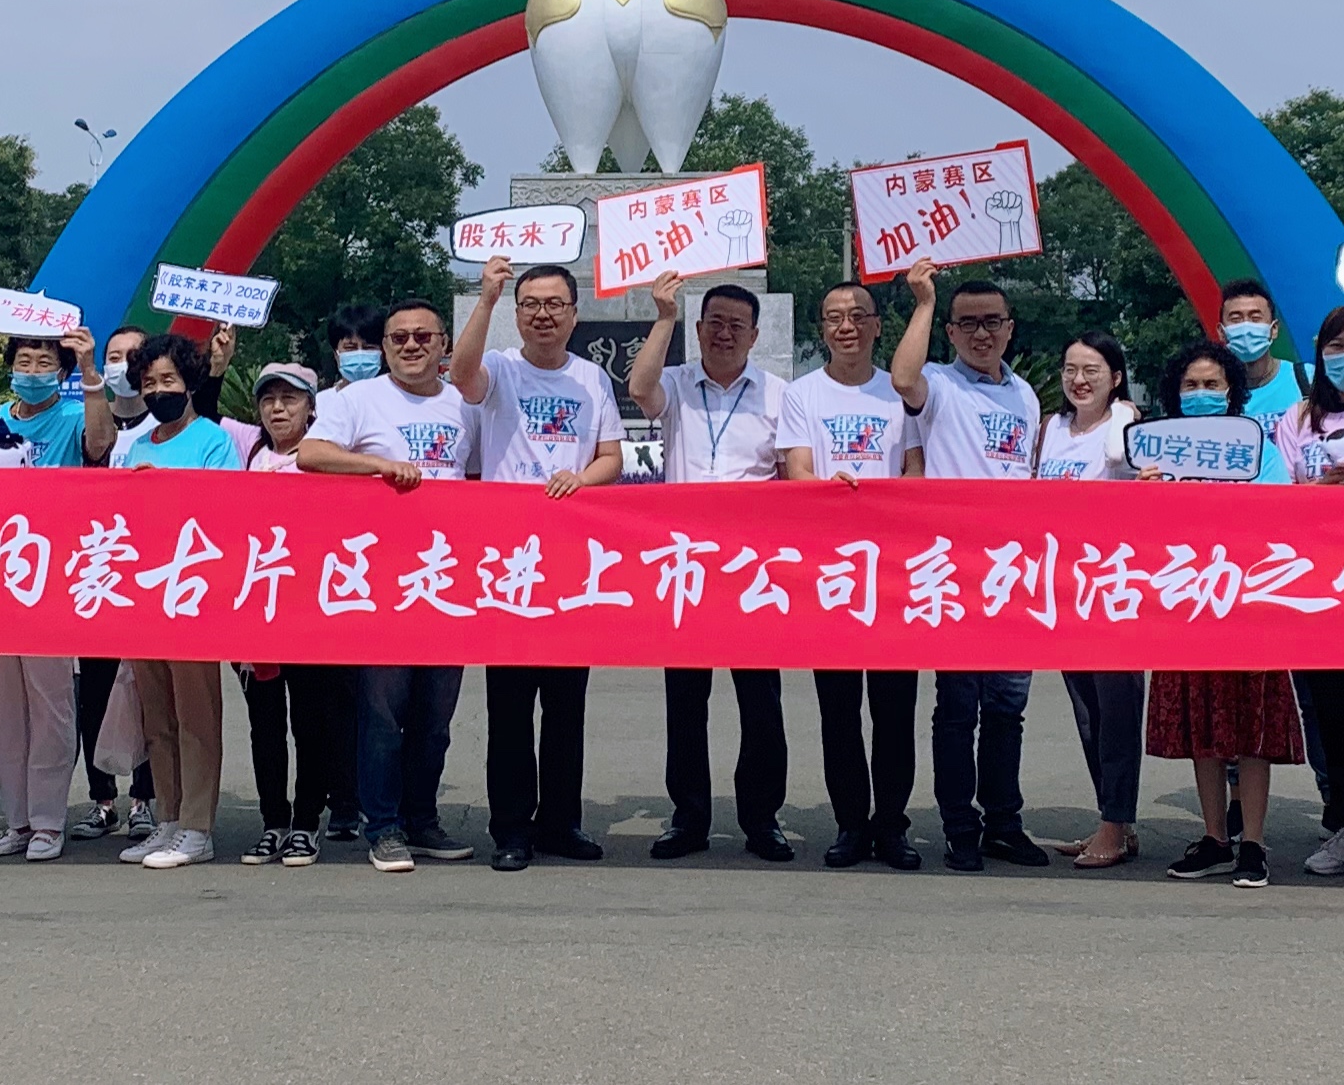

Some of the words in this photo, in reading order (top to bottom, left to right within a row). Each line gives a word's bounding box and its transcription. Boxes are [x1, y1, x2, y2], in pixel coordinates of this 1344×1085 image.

[885, 160, 995, 198] 内蒙赛区
[628, 183, 729, 221] 内蒙赛区
[458, 221, 575, 248] 股东来了
[154, 290, 262, 321] 内蒙片区正式启动
[1132, 431, 1254, 473] 知学竞赛
